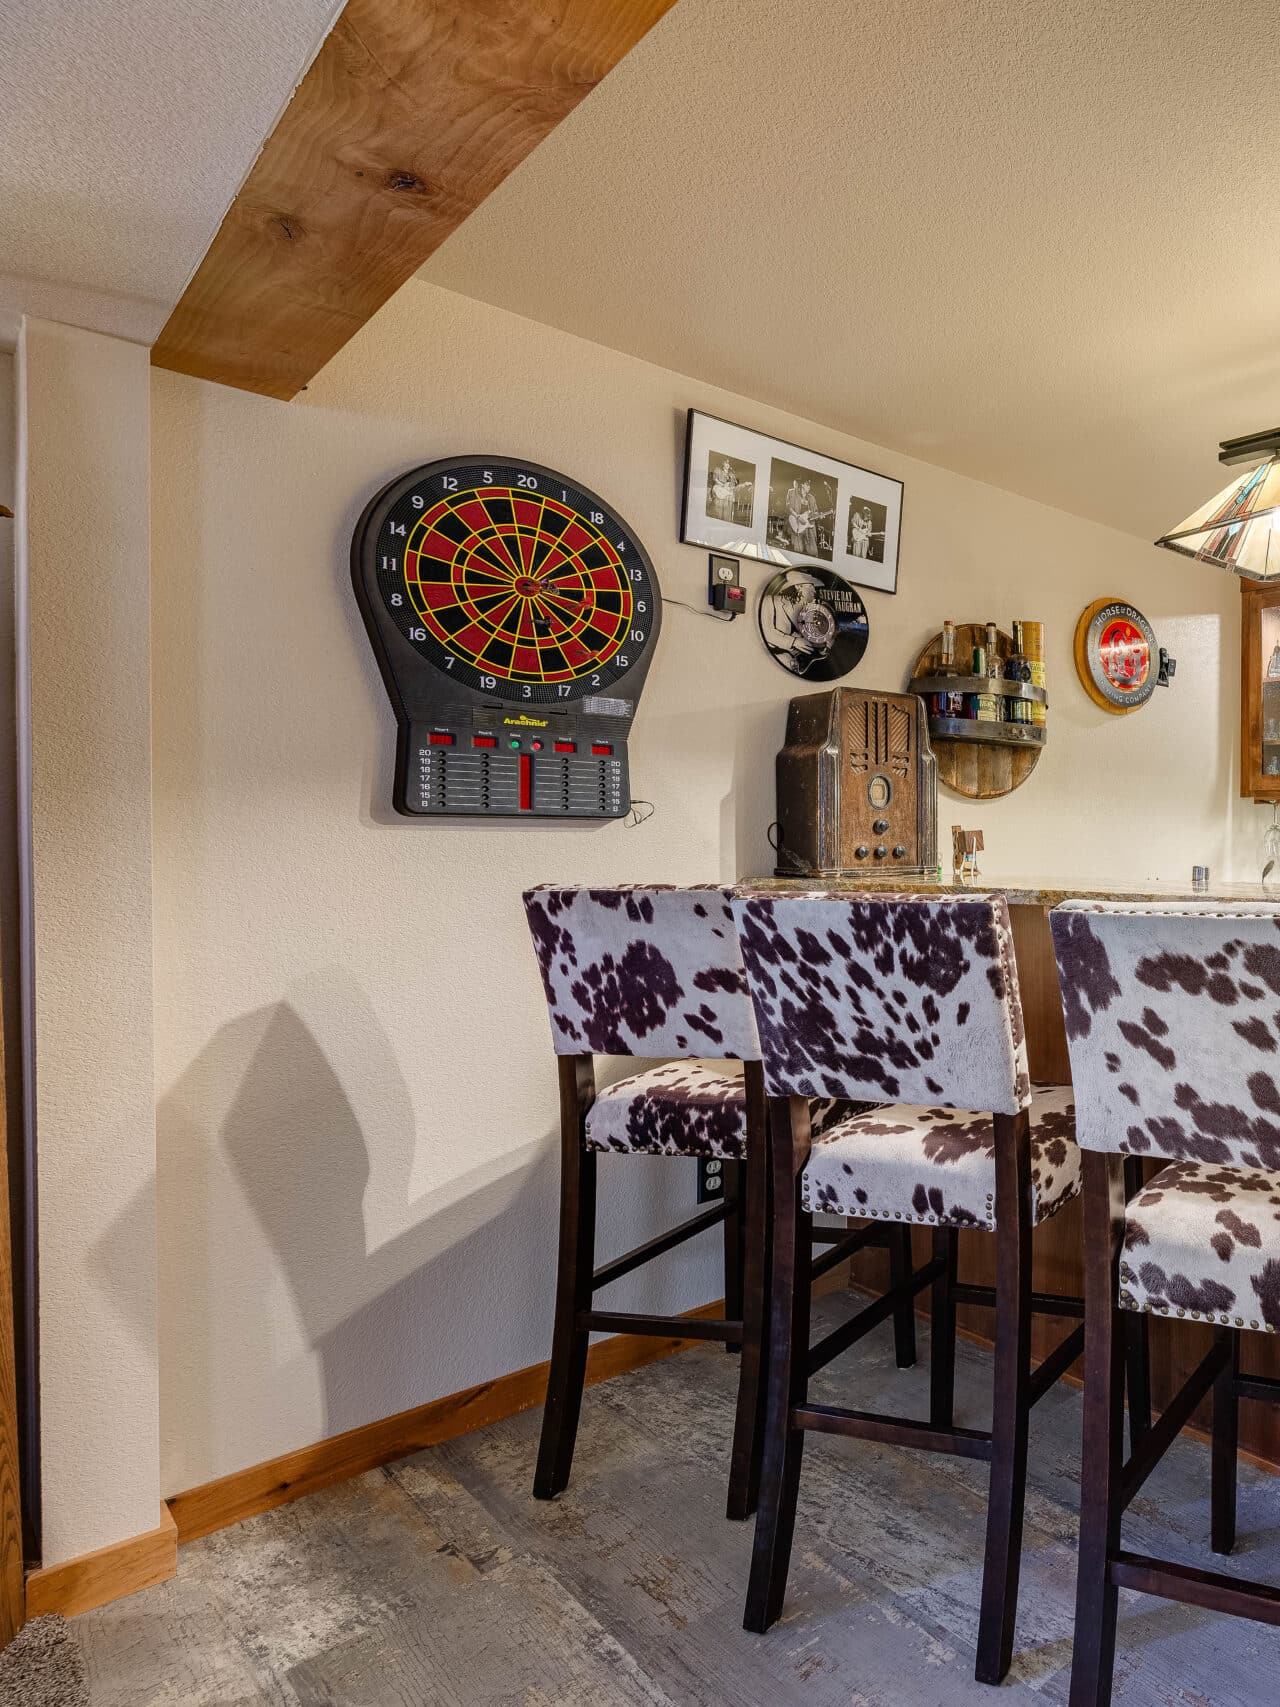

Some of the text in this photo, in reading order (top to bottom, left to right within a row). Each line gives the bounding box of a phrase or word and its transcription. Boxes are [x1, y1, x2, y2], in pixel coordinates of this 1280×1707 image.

[442, 476, 458, 491] 12
[482, 471, 493, 484] 5
[517, 474, 538, 490] 20
[412, 496, 424, 508] 9
[560, 490, 567, 502] 1
[589, 511, 605, 524] 18
[389, 522, 407, 536] 14
[616, 540, 626, 552] 4
[381, 556, 398, 570] 11
[629, 569, 642, 581] 13
[390, 593, 402, 606] 8
[819, 589, 841, 601] STEVIE
[636, 601, 646, 612] 6
[1096, 606, 1121, 626] HORSE
[1126, 607, 1155, 643] DRAGON
[408, 627, 427, 641] 16
[630, 629, 644, 642] 10
[445, 656, 454, 669] 7
[615, 654, 629, 667] 15
[480, 676, 496, 689] 19
[591, 674, 600, 686] 2
[522, 685, 532, 698] 3
[557, 684, 571, 696] 17
[504, 716, 547, 728] Arachnid
